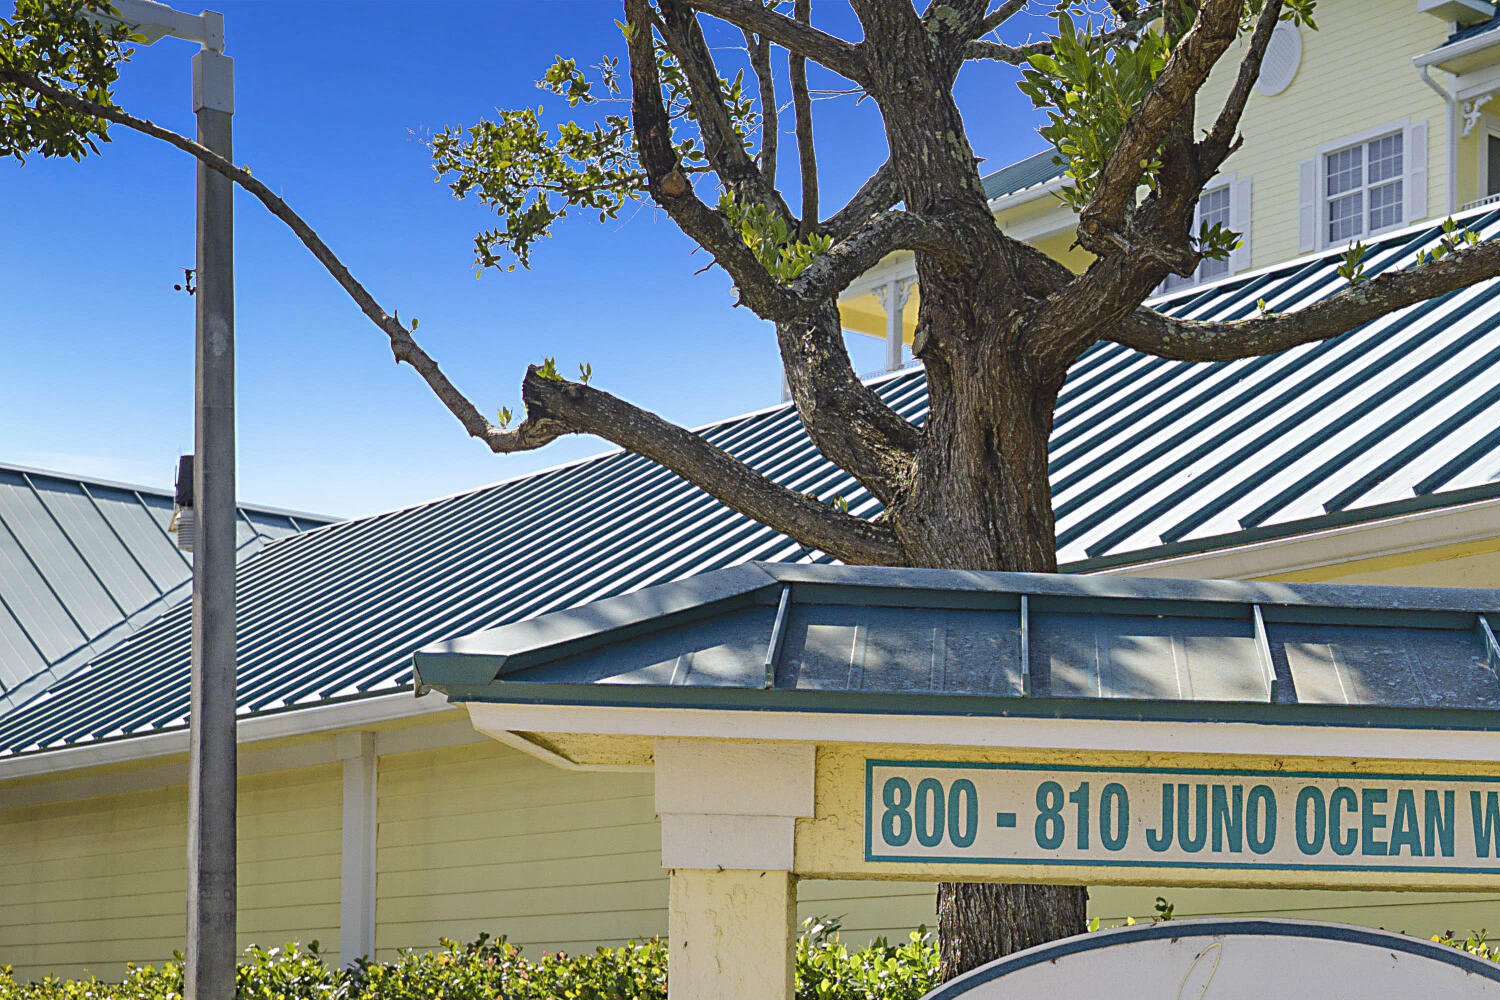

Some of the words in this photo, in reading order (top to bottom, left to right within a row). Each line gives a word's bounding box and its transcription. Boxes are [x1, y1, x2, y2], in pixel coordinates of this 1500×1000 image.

[881, 777, 979, 848] 800
[996, 813, 1016, 828] -
[1035, 781, 1130, 851] 810
[1145, 783, 1277, 855] JUNO
[1295, 785, 1455, 858] OCEAN
